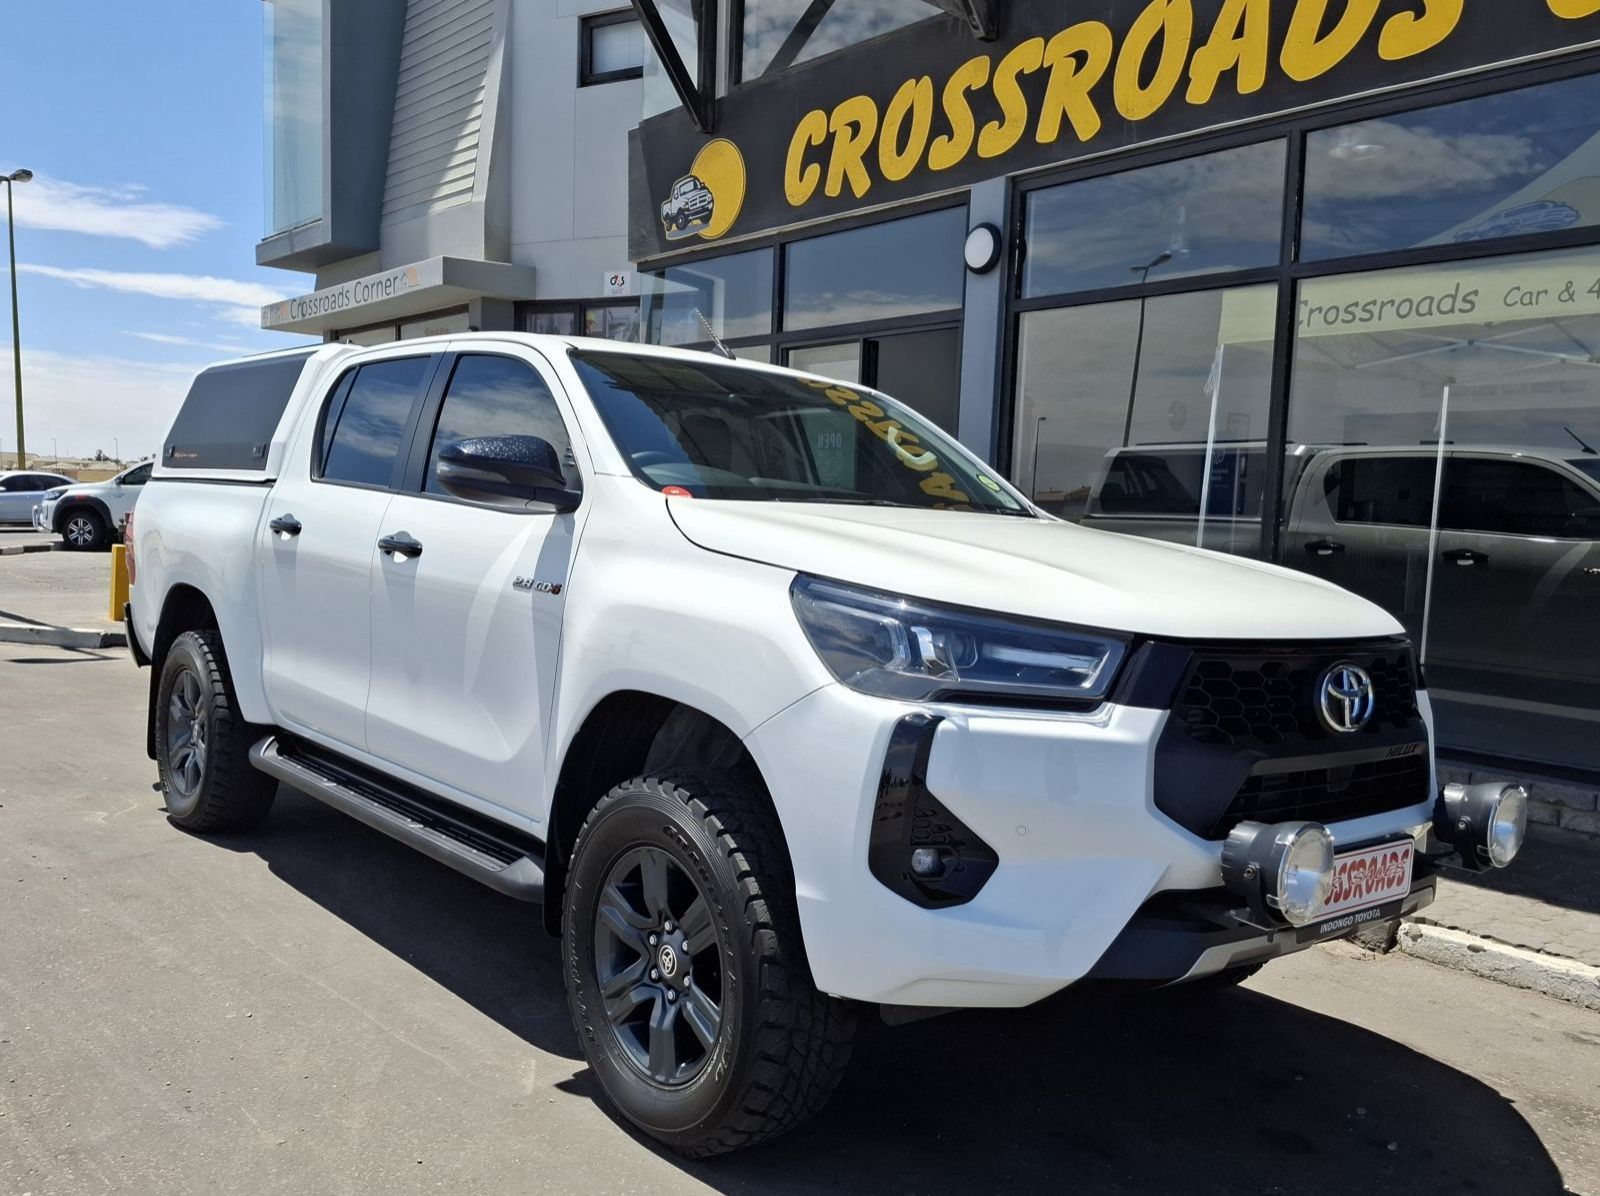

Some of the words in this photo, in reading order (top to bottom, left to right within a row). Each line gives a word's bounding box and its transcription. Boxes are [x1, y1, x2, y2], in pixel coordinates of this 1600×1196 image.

[290, 287, 350, 320] Crossroads
[354, 275, 399, 304] Corner
[1503, 286, 1548, 307] Car
[1558, 281, 1575, 303] &
[1320, 916, 1354, 934] INDONGO
[1355, 908, 1381, 925] TOYOTA
